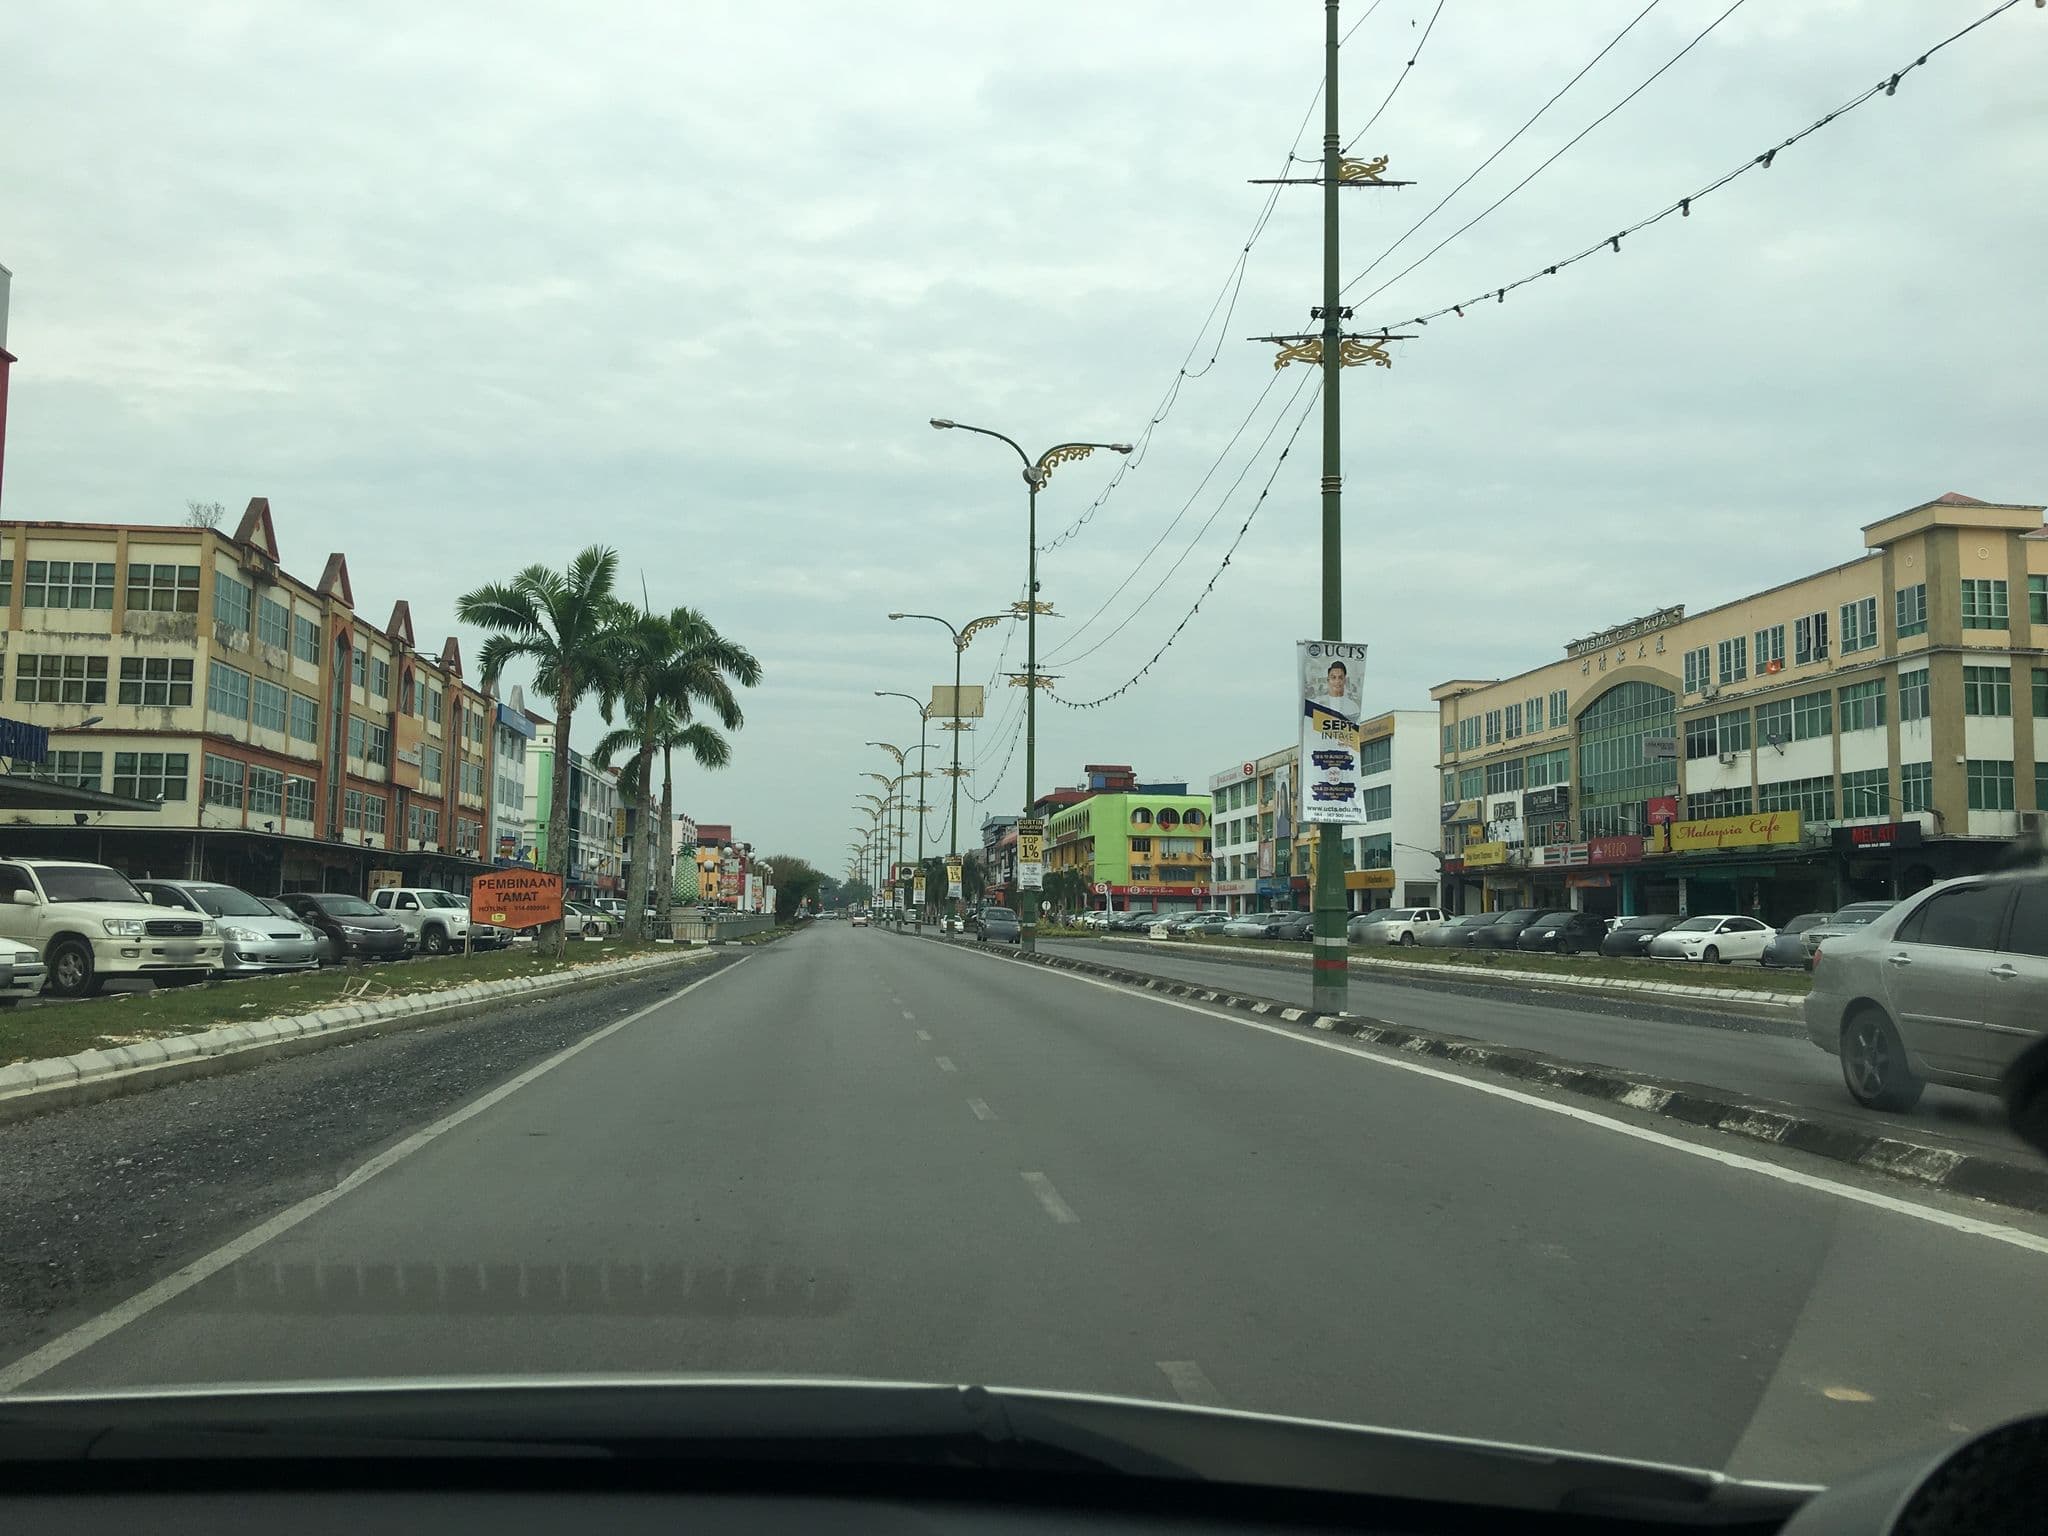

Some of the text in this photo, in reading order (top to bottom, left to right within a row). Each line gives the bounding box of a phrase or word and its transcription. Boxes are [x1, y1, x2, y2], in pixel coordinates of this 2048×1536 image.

[1577, 634, 1612, 653] WISMA
[1324, 644, 1365, 660] UCTS
[1322, 719, 1354, 732] SEPT
[1677, 814, 1781, 846] Malaysia Cafe
[1022, 836, 1039, 844] TOP
[1022, 844, 1039, 858] 1%
[478, 878, 556, 890] PEMBINAAN
[495, 891, 539, 902] TAMAT
